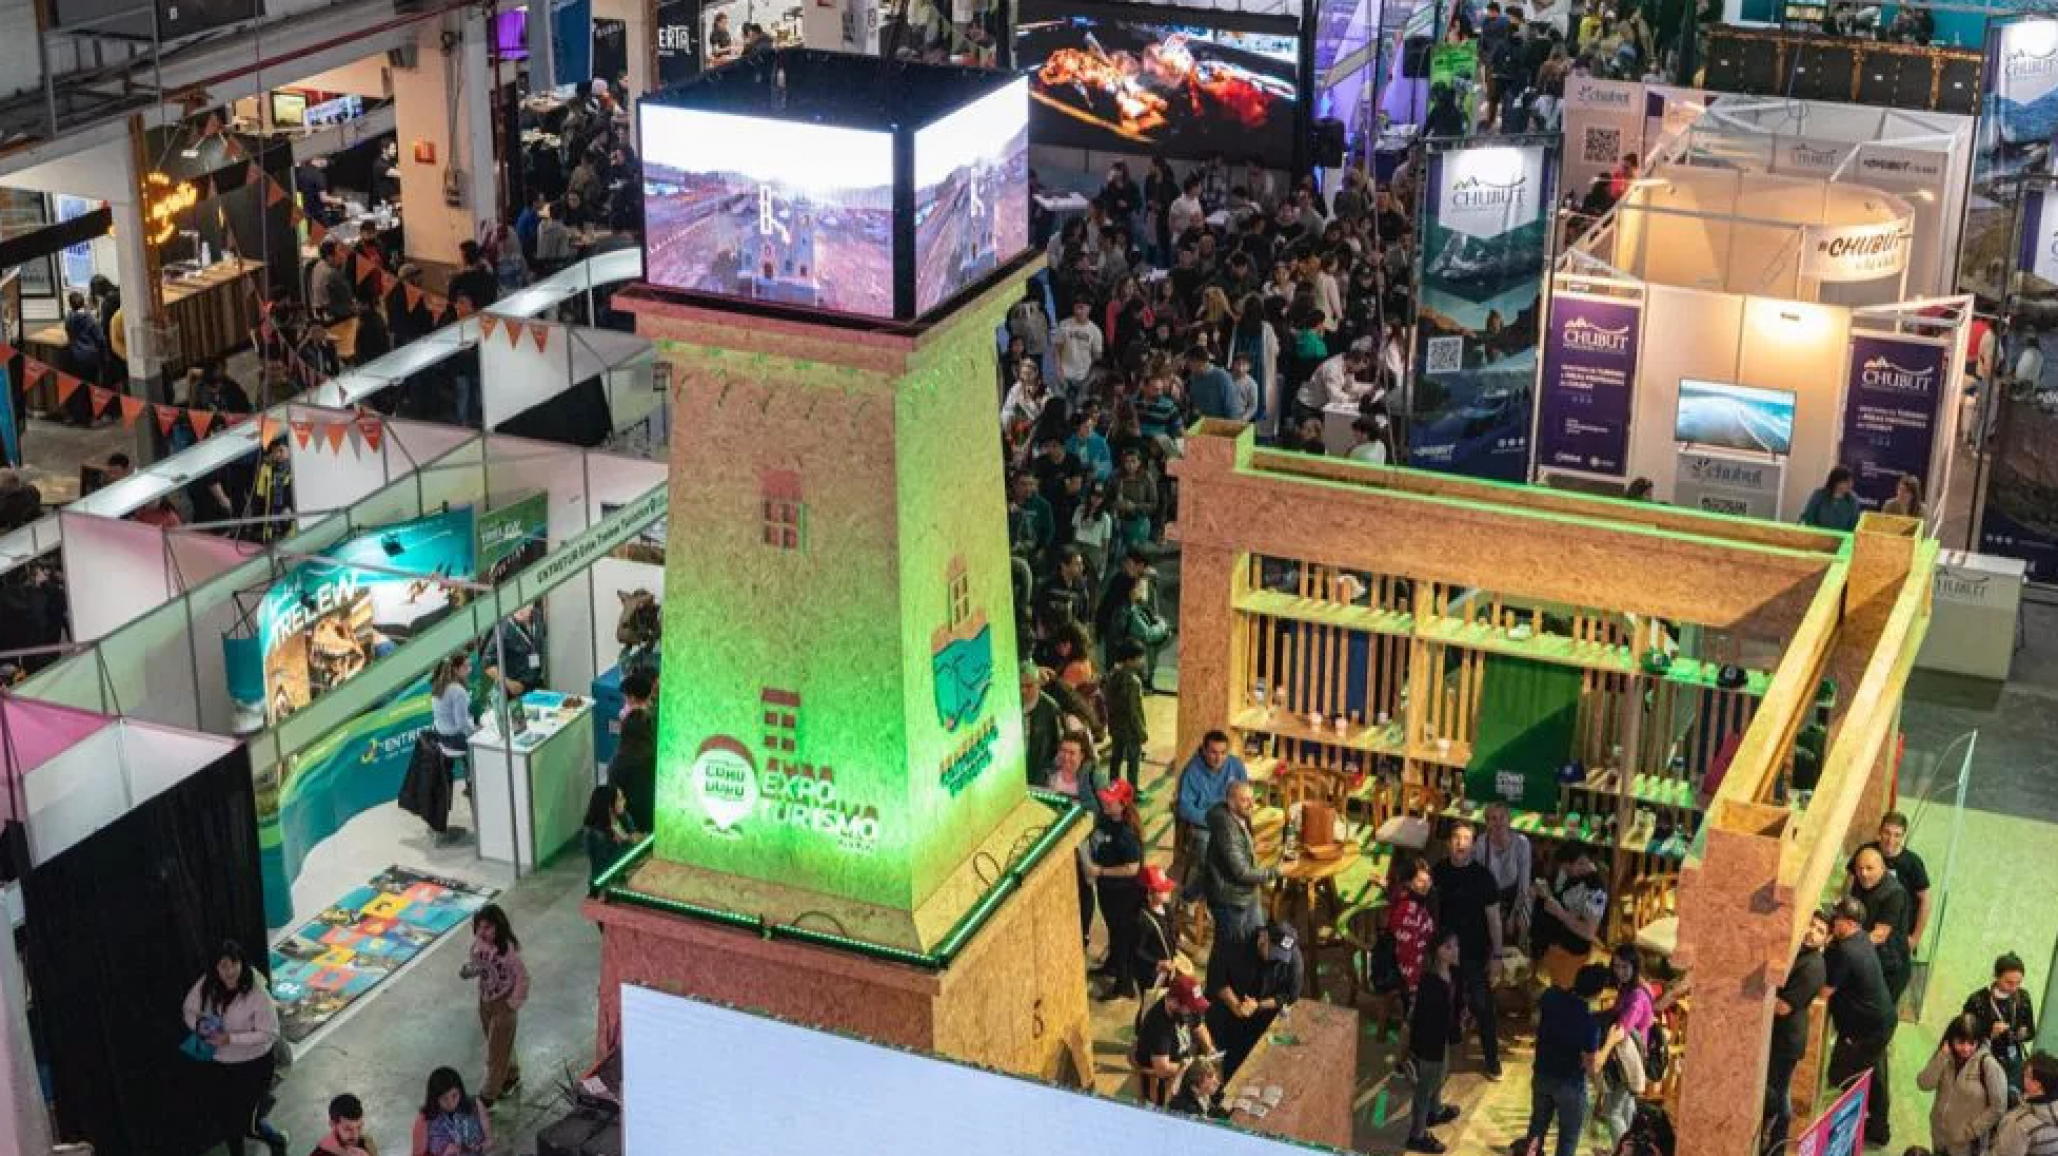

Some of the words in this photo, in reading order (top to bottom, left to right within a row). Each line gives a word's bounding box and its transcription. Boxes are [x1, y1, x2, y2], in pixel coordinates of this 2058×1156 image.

[1453, 189, 1525, 206] CHUBUT
[1563, 331, 1628, 349] CHUBUT
[1862, 371, 1932, 391] CHUBUT
[272, 568, 358, 648] TRELEW
[763, 771, 835, 802] EXPO
[761, 800, 878, 840] TURISMO
